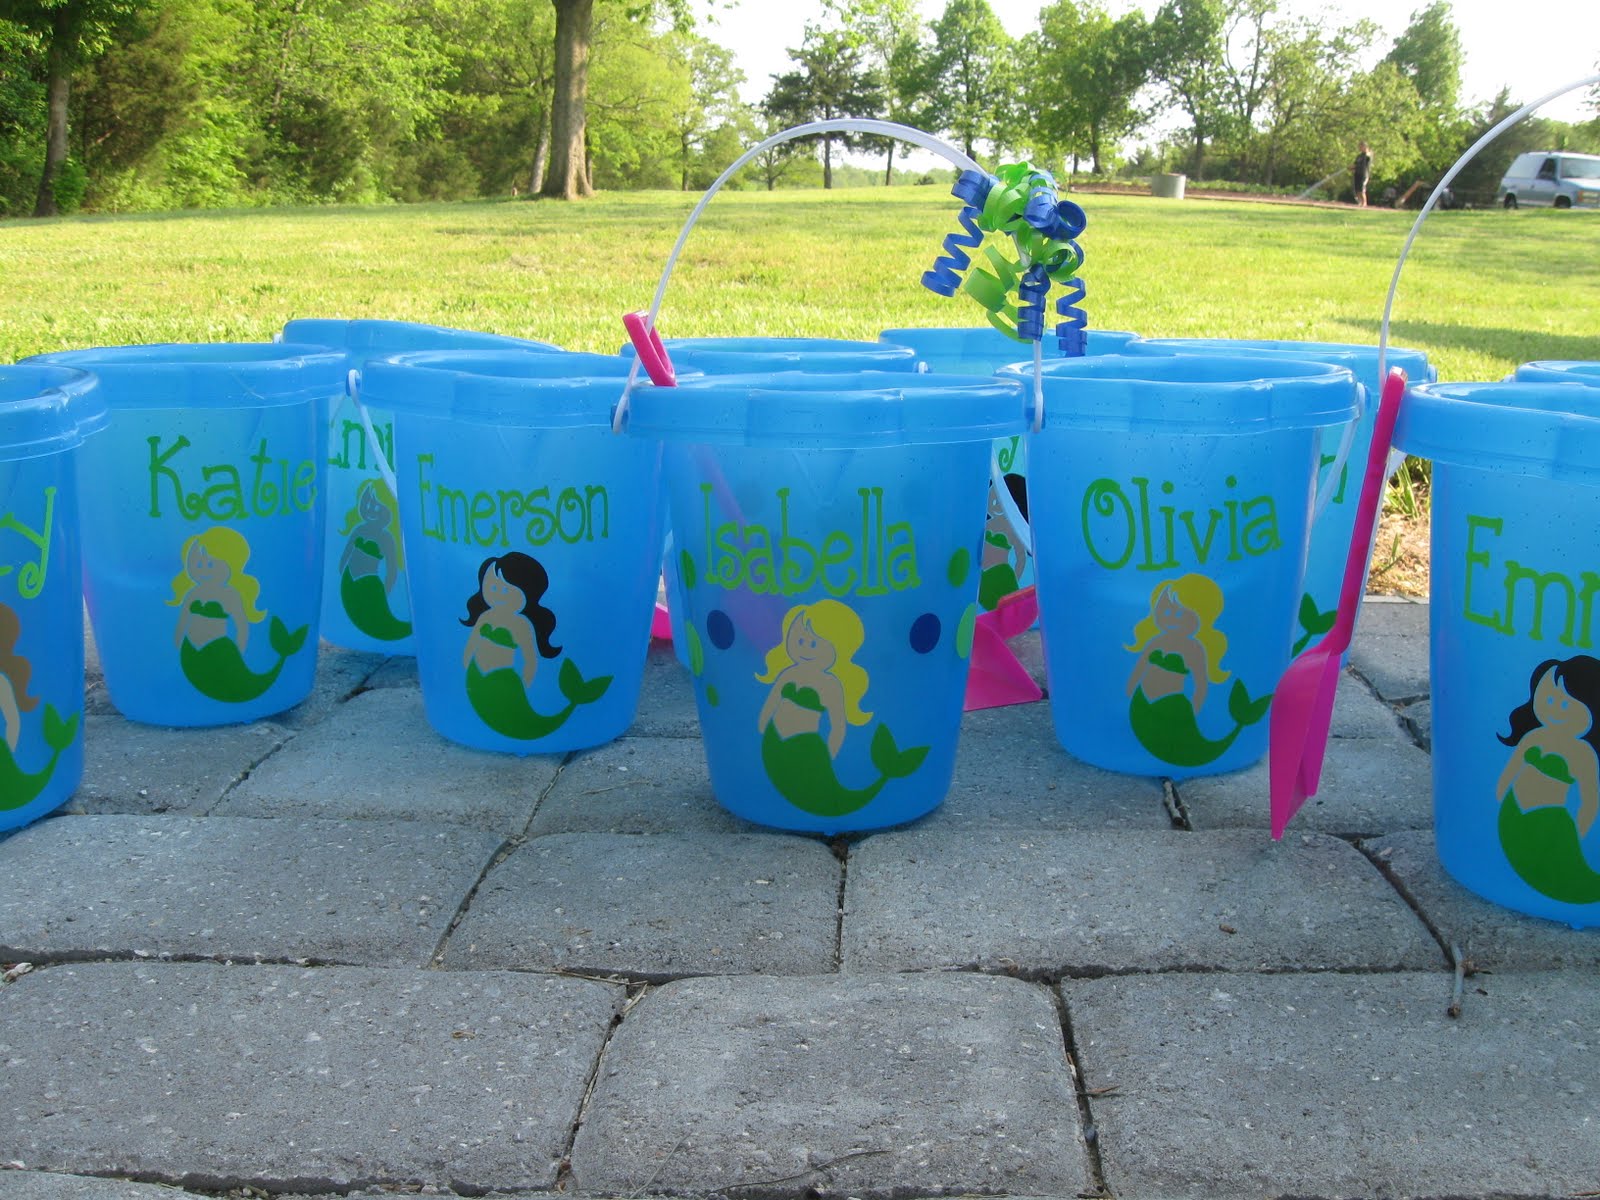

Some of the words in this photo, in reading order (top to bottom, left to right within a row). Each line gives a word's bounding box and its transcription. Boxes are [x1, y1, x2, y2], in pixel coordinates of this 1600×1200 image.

[146, 435, 317, 521] Katie
[417, 453, 609, 548] Emerson
[1081, 475, 1283, 571] Olivia
[699, 482, 922, 597] Isabella
